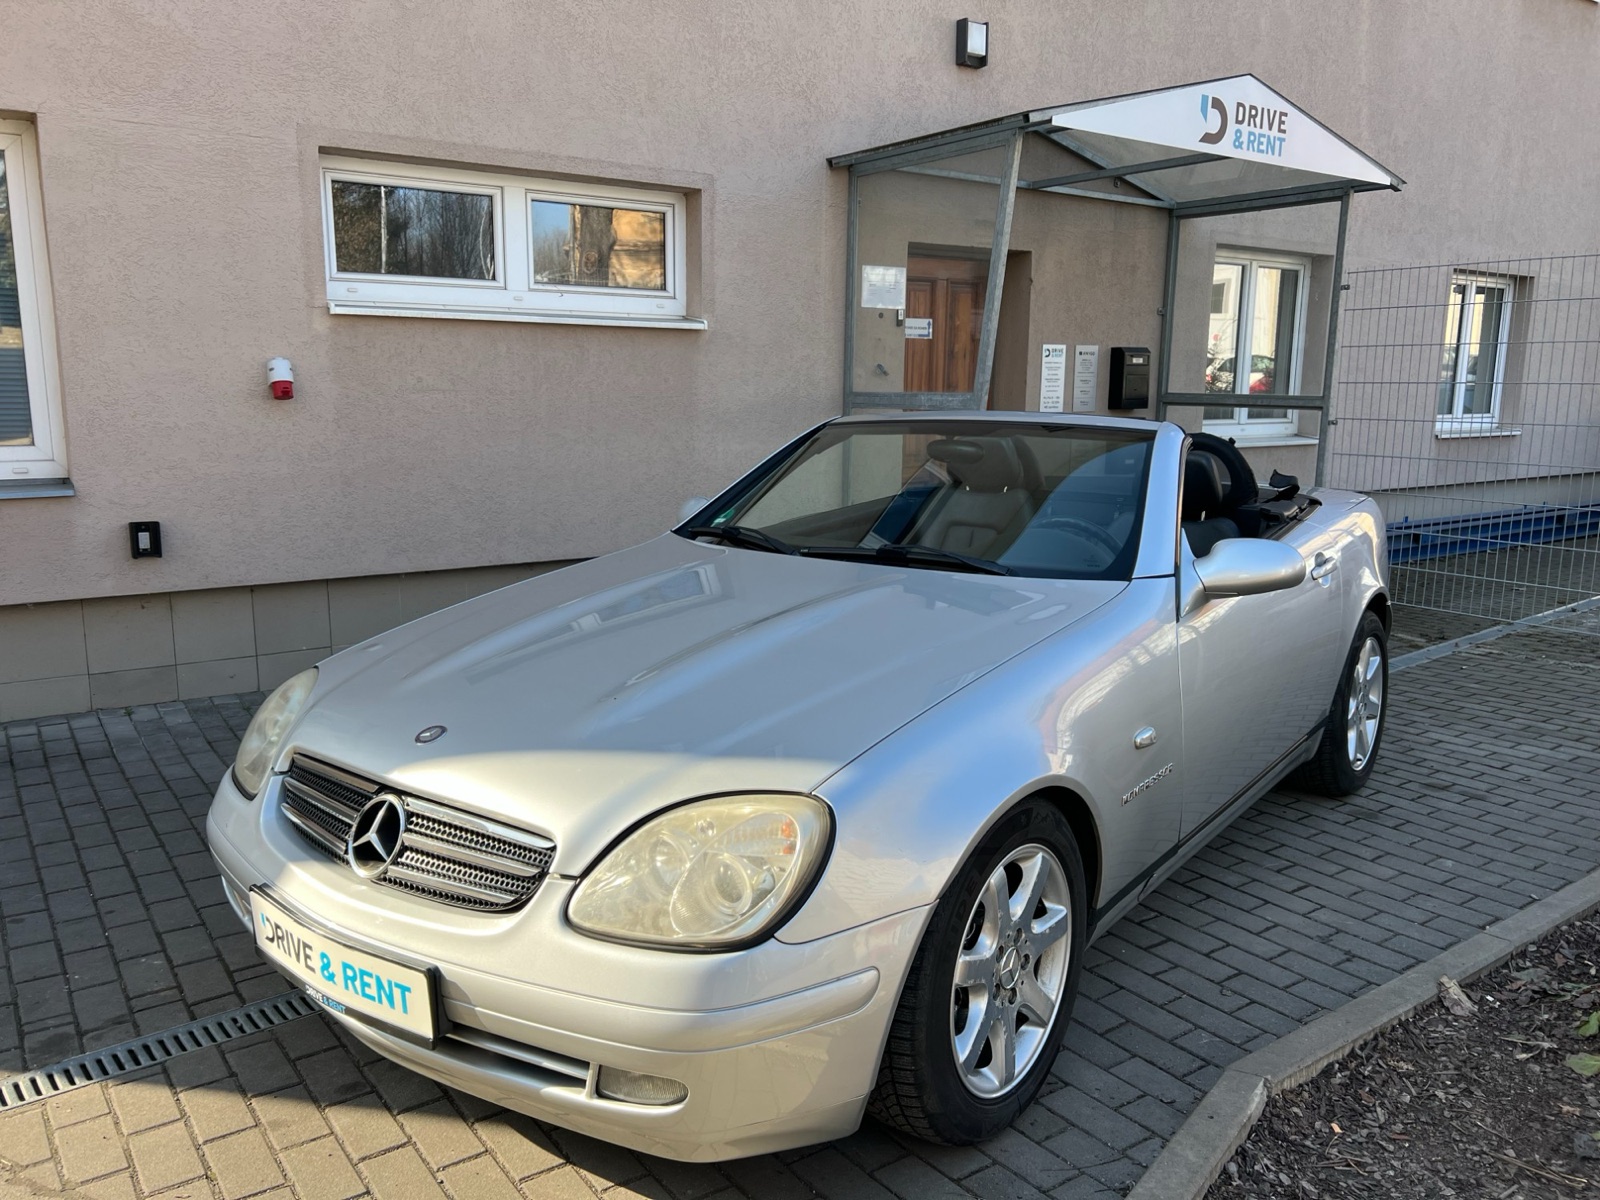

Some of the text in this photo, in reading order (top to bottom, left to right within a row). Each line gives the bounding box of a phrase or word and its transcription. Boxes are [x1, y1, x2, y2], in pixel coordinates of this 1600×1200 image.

[1235, 101, 1288, 135] DRIVE
[1233, 128, 1286, 158] & RENT
[260, 912, 412, 1015] DRIVE & RENT
[305, 984, 323, 1003] DRIVE
[328, 999, 346, 1014] RENT
